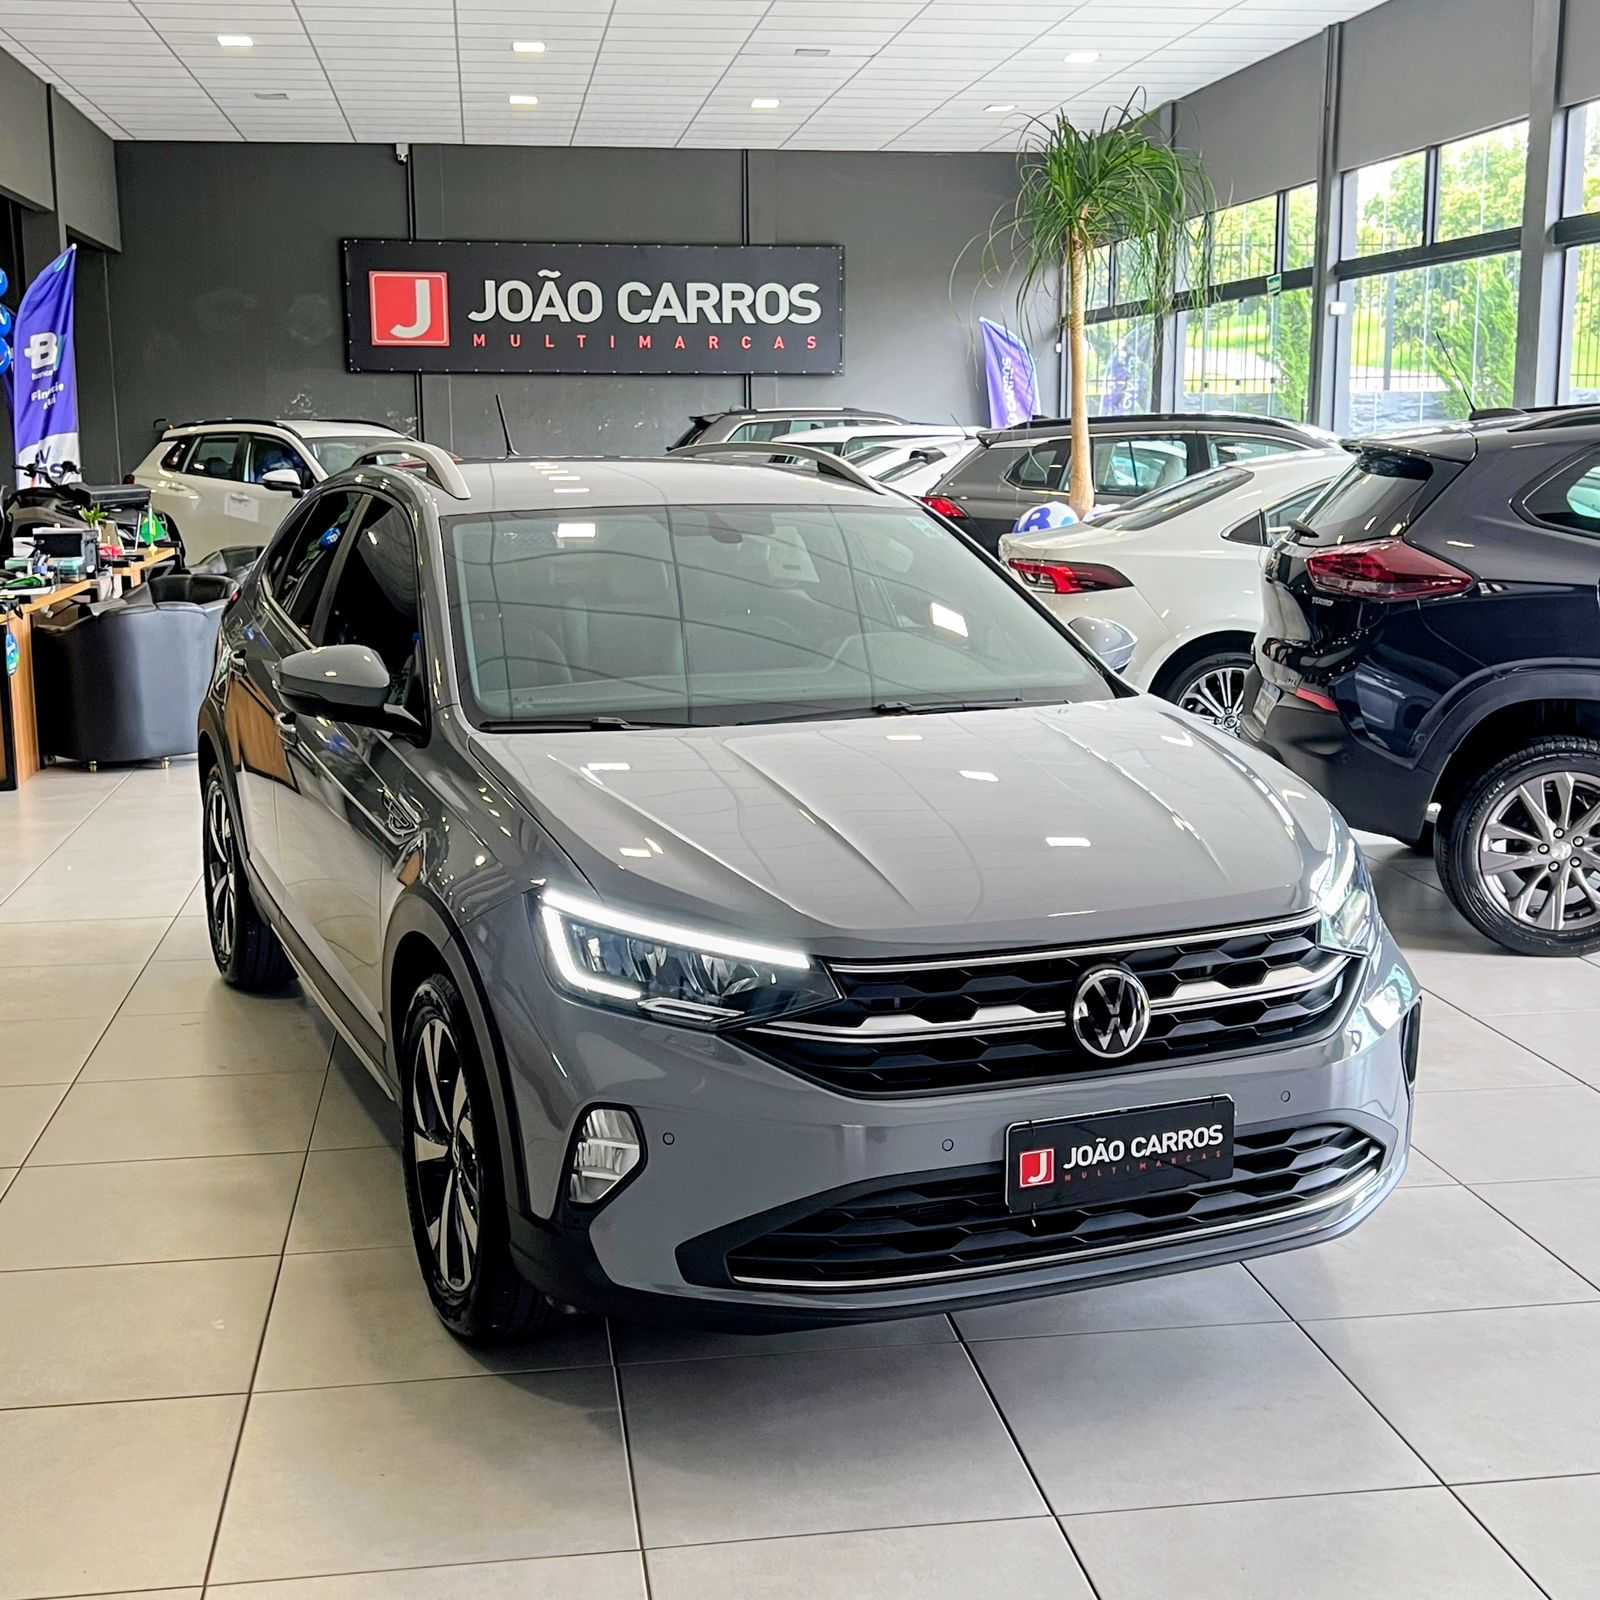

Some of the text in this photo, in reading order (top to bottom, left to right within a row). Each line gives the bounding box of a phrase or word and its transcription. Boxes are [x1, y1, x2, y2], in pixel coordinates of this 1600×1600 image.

[389, 278, 431, 338] J
[467, 269, 823, 326] JOÃO CARROS
[473, 334, 817, 350] MULTIMARCAS
[1027, 1152, 1048, 1184] J
[1063, 1124, 1223, 1169] JOÃO CARROS
